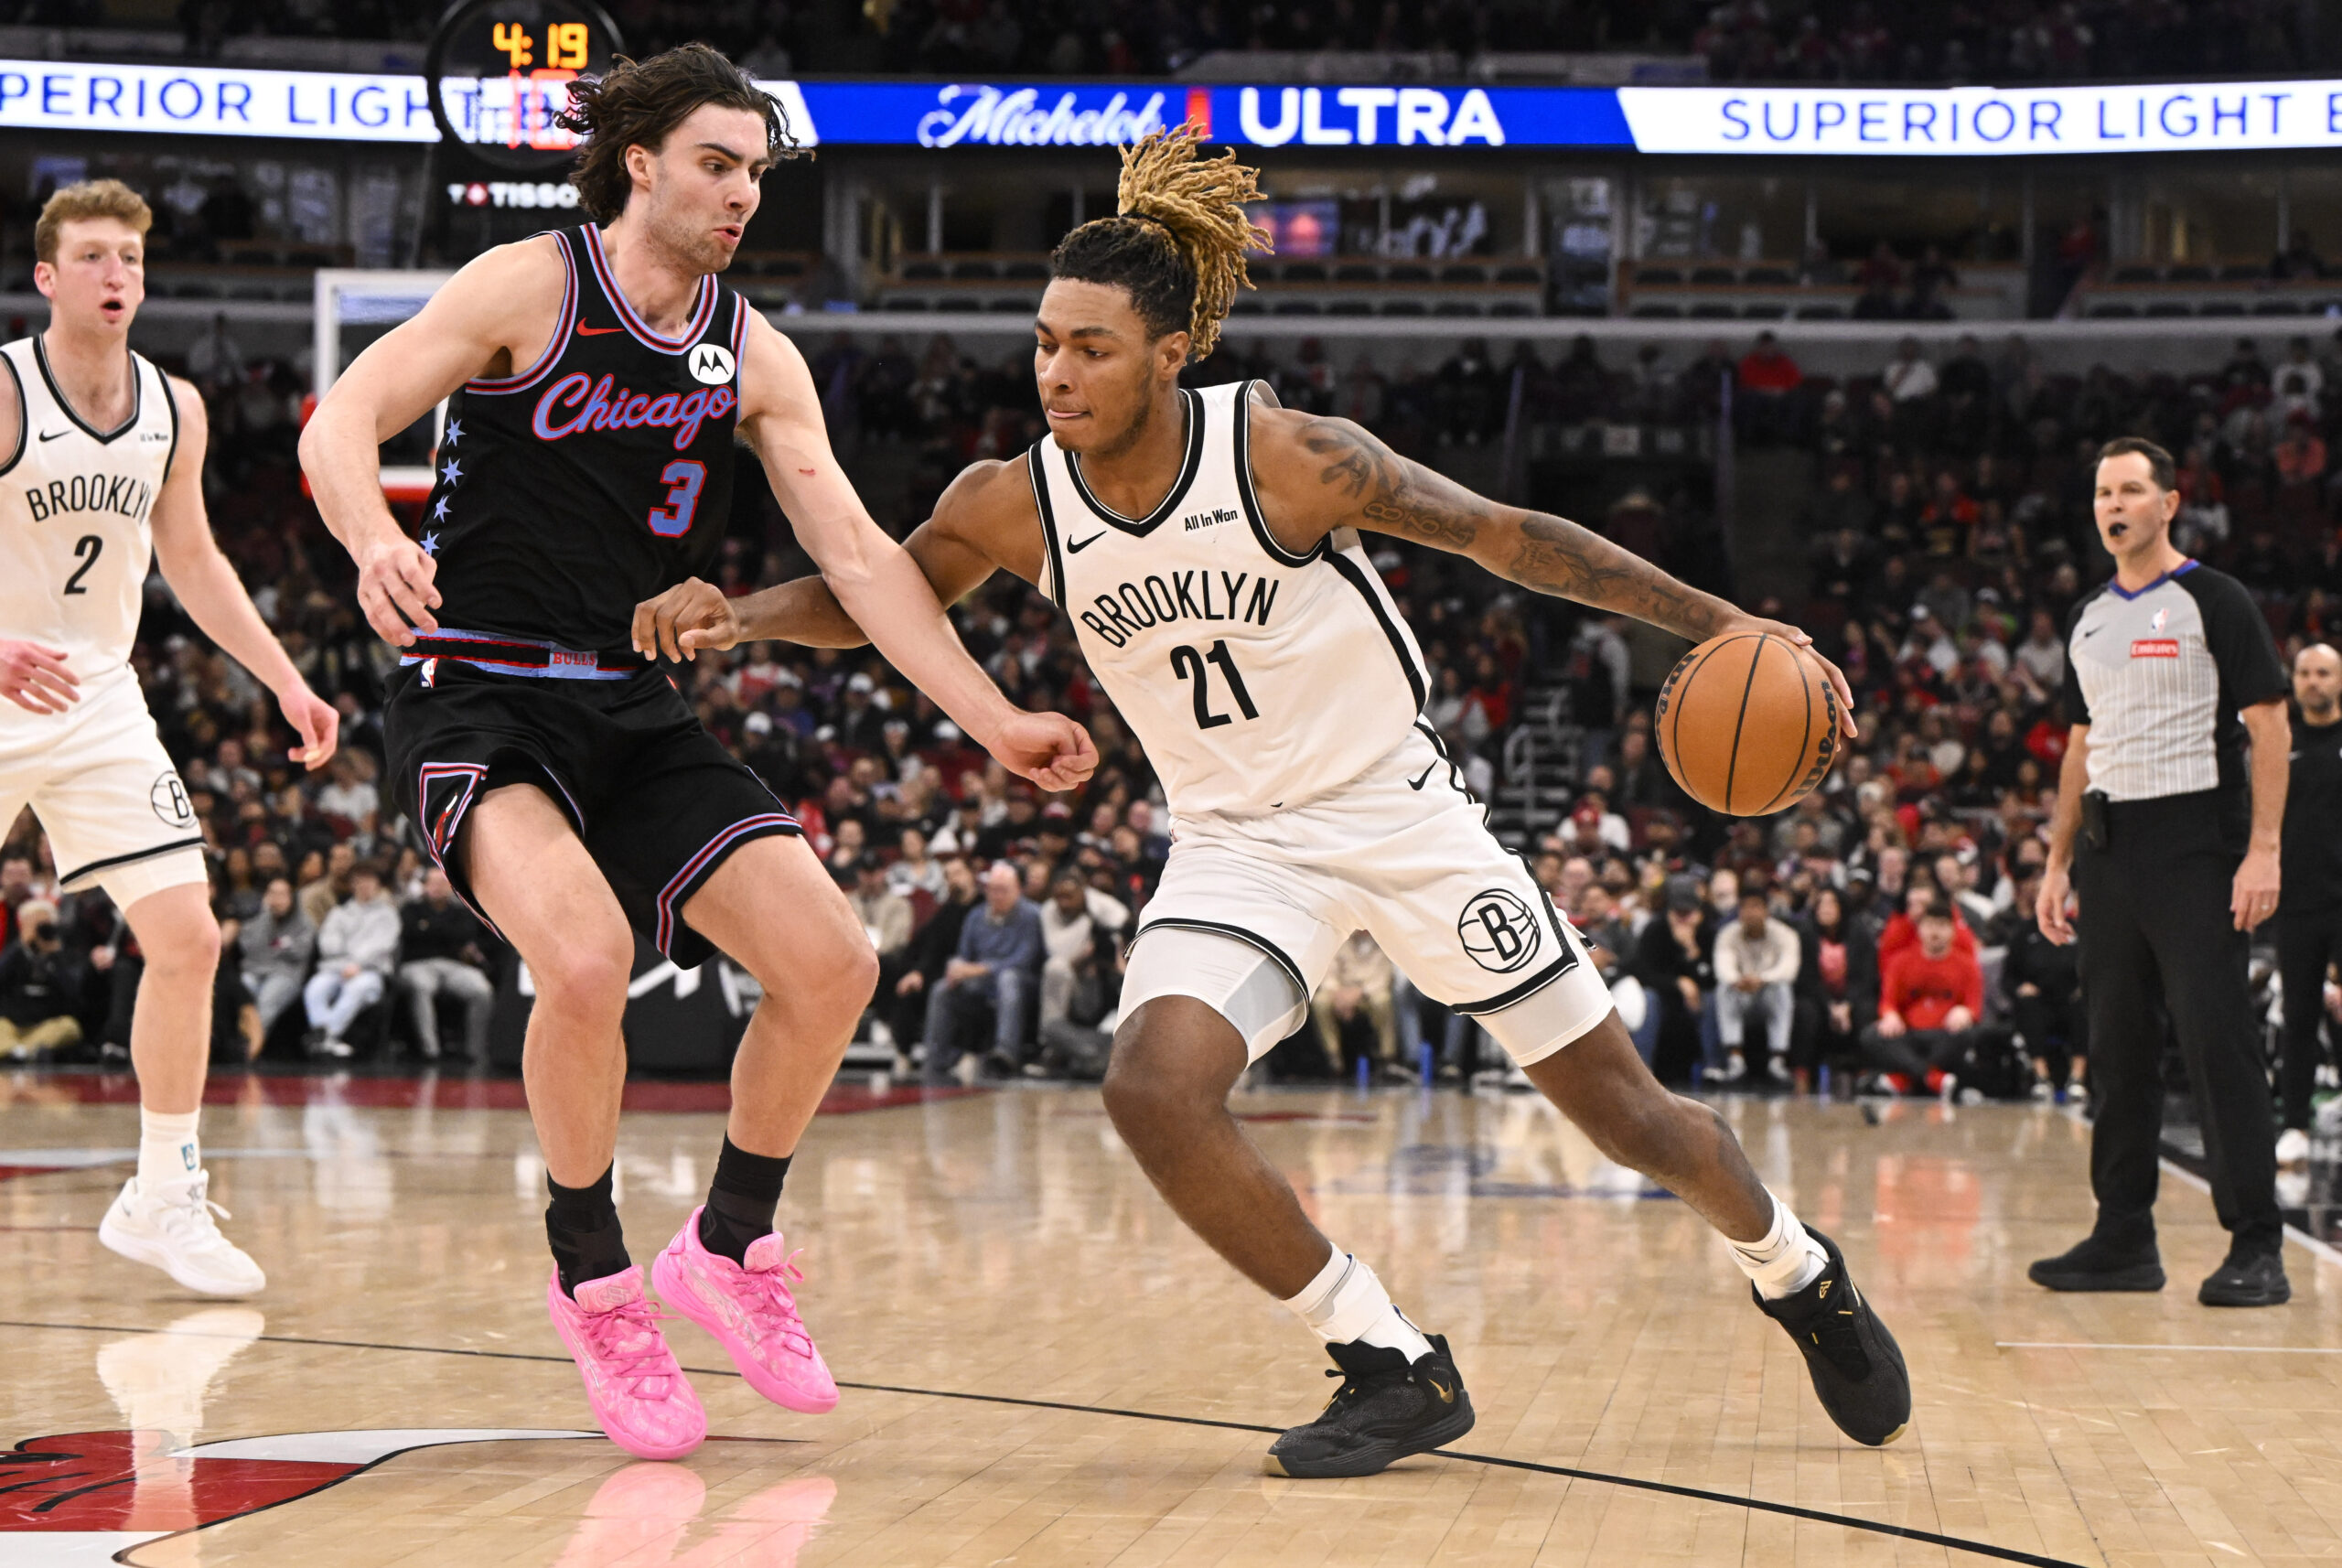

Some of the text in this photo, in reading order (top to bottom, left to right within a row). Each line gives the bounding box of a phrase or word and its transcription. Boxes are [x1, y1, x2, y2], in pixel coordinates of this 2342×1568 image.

[493, 22, 588, 70] 4:19
[0, 72, 252, 123] PERIOR
[917, 84, 1506, 148] Michelob ULTRA
[1721, 98, 2063, 142] SUPERIOR
[2098, 92, 2293, 139] LIGHT
[532, 371, 738, 451] Chicago
[26, 473, 151, 528] BROOKLYN
[647, 458, 708, 539] 3
[1185, 509, 1239, 532] All In Won
[63, 533, 103, 596] 2
[1080, 570, 1280, 649] BROOKLYN
[552, 651, 597, 666] BULLS
[1169, 639, 1260, 730] 21
[1789, 680, 1838, 797] Wilson
[1477, 902, 1522, 961] B
